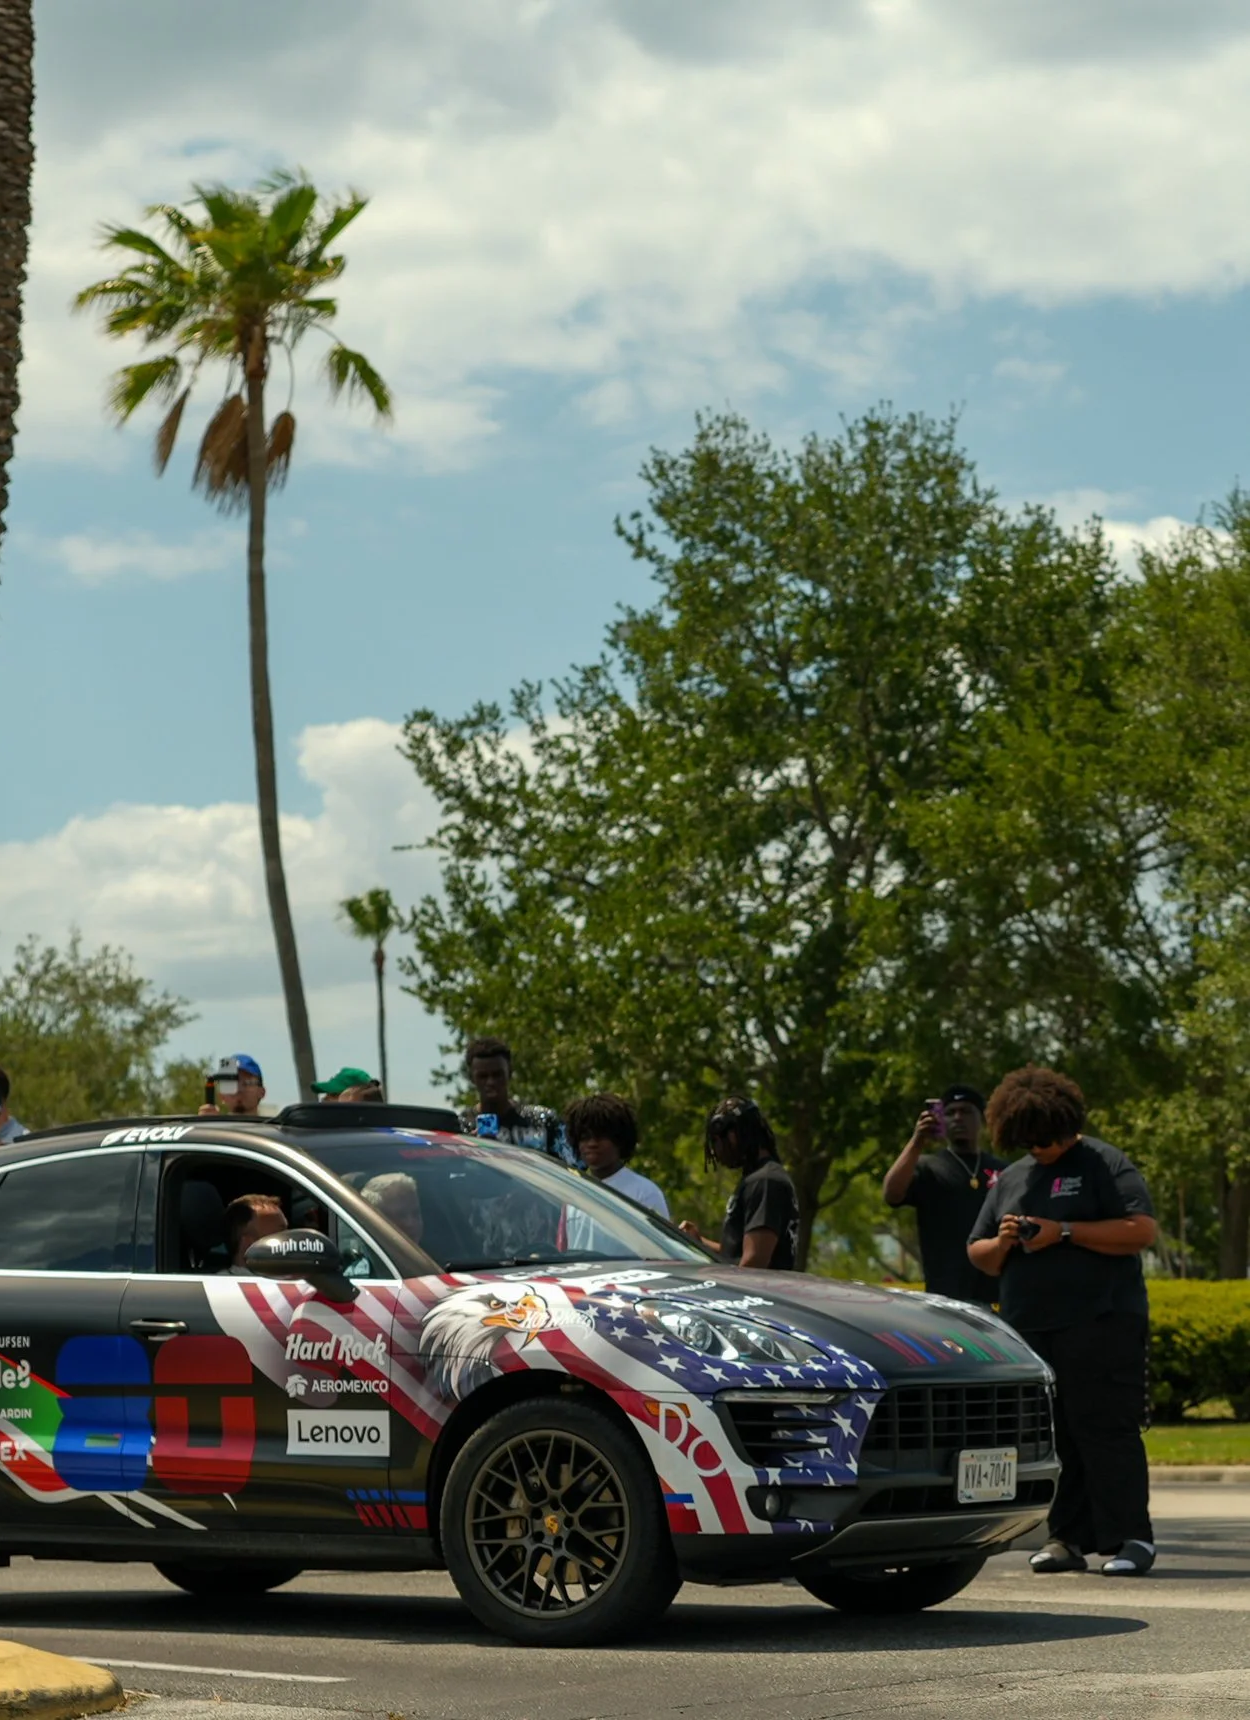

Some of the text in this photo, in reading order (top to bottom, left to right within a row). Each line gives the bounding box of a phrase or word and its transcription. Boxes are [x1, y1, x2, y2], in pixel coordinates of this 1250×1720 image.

[299, 1239, 324, 1253] club
[285, 1333, 387, 1366] Hard Rock
[311, 1379, 389, 1393] AEROMEXICO
[298, 1420, 381, 1444] Lenovo
